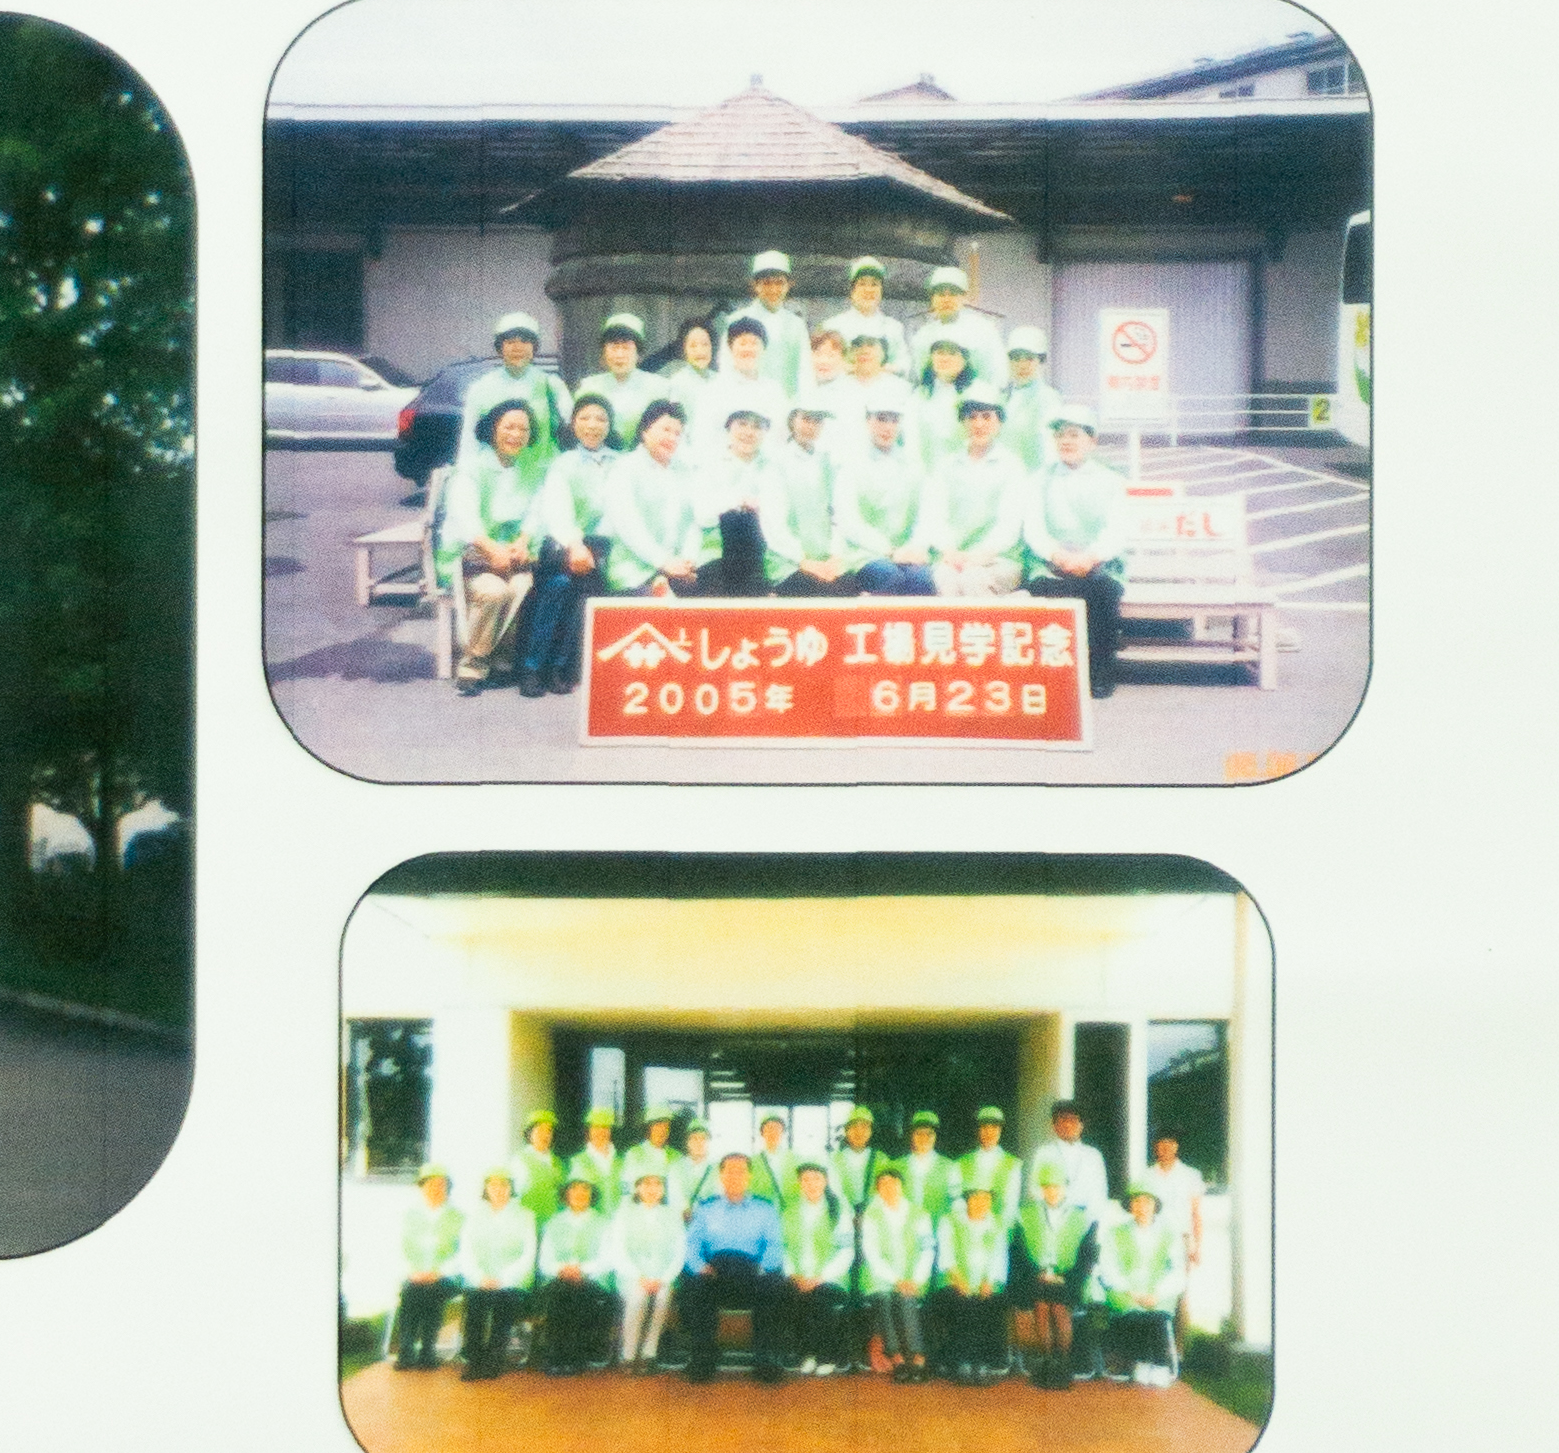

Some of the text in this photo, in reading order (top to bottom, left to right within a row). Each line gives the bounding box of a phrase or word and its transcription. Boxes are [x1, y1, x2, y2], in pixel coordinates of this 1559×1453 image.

[698, 624, 829, 671] しょうゆ
[623, 679, 1048, 716] 2005年 6月23日
